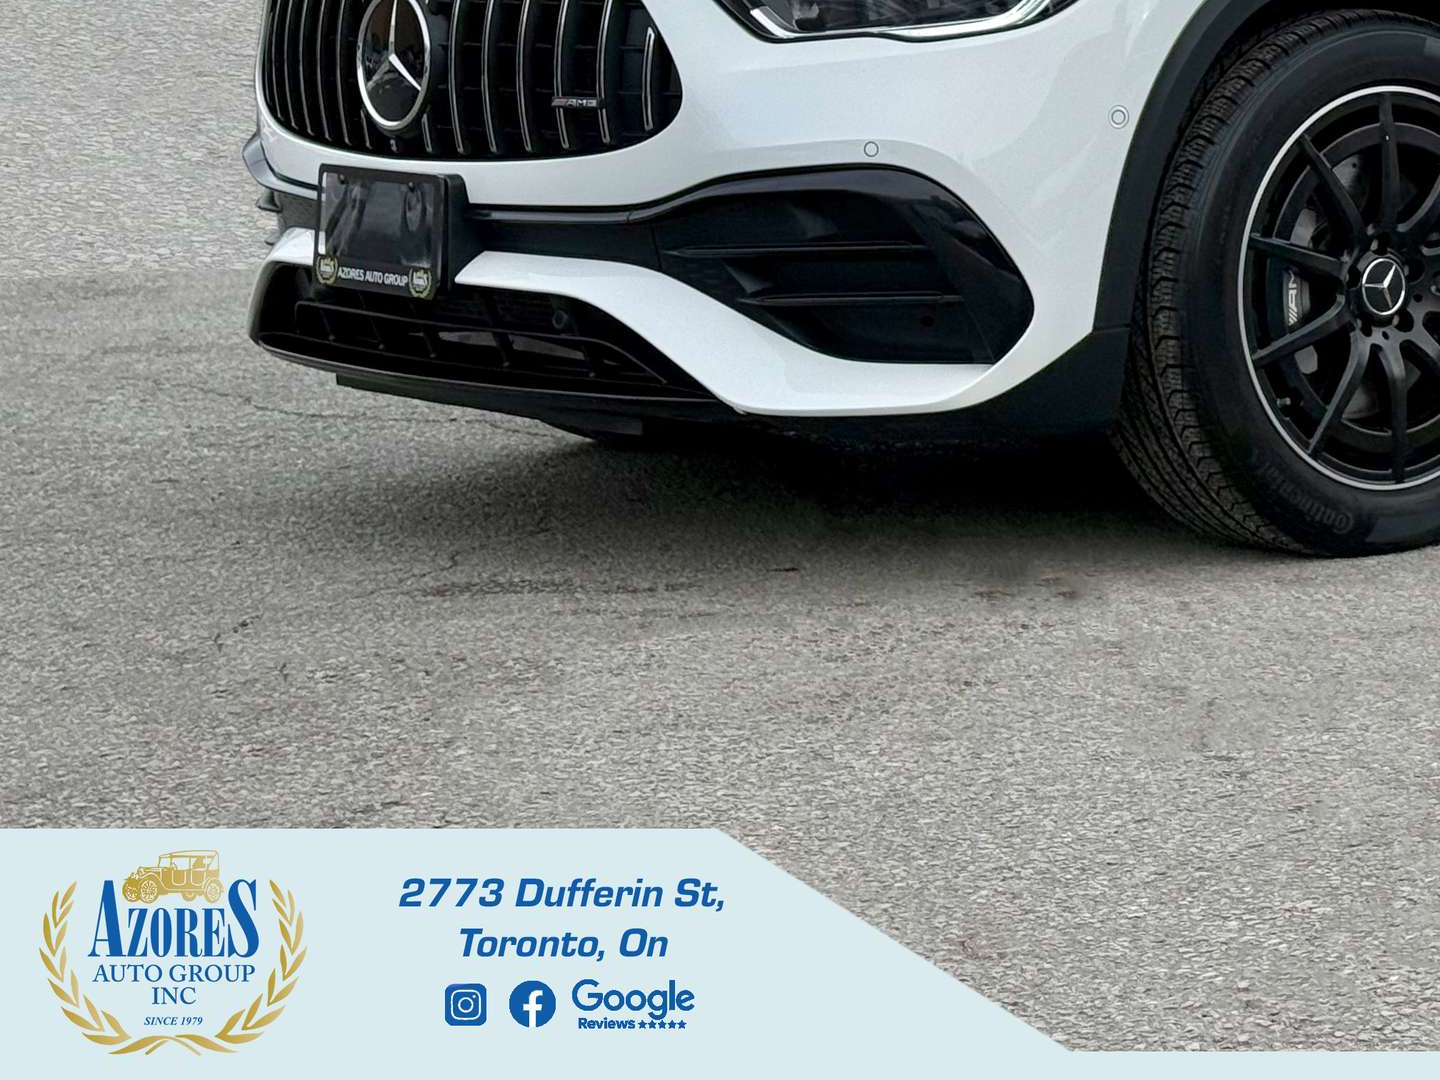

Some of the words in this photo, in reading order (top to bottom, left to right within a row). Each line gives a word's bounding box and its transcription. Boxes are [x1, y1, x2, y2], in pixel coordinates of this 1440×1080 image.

[337, 266, 365, 282] AZORES
[365, 270, 382, 284] AUTO
[383, 273, 408, 287] GROUP
